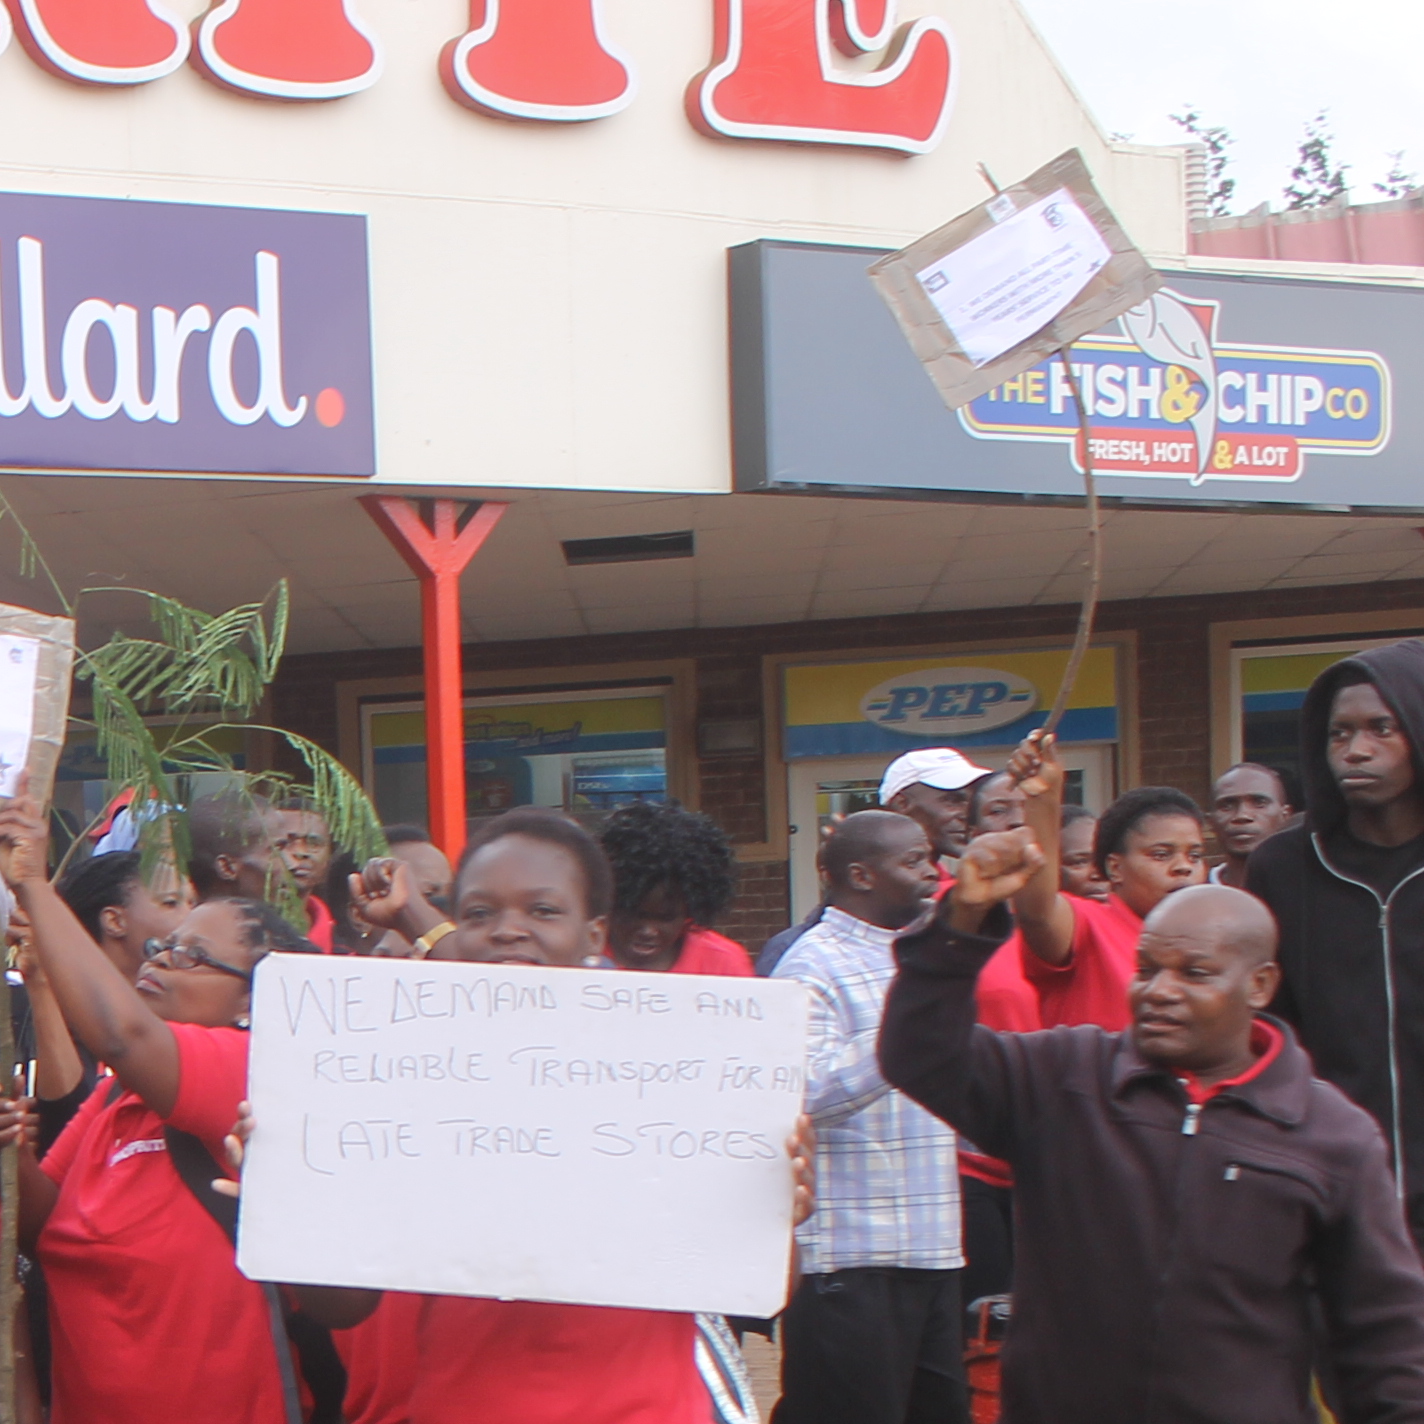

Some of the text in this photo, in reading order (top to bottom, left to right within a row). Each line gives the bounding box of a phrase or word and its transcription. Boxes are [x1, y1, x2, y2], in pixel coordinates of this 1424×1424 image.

[1050, 362, 1162, 419] FISH
[1217, 370, 1324, 426] CHIP
[1325, 387, 1370, 420] CO
[1152, 442, 1194, 463] HOT
[1234, 446, 1251, 465] A
[1251, 446, 1289, 467] LOT
[878, 681, 1009, 722] PEP
[279, 976, 764, 1036] WE DEMAND SAFE AND
[313, 1047, 491, 1084] RELIABLE
[508, 1046, 706, 1099] TRANSPORT
[717, 1056, 764, 1092] FOR
[302, 1113, 779, 1176] LATE TRADE STORES
